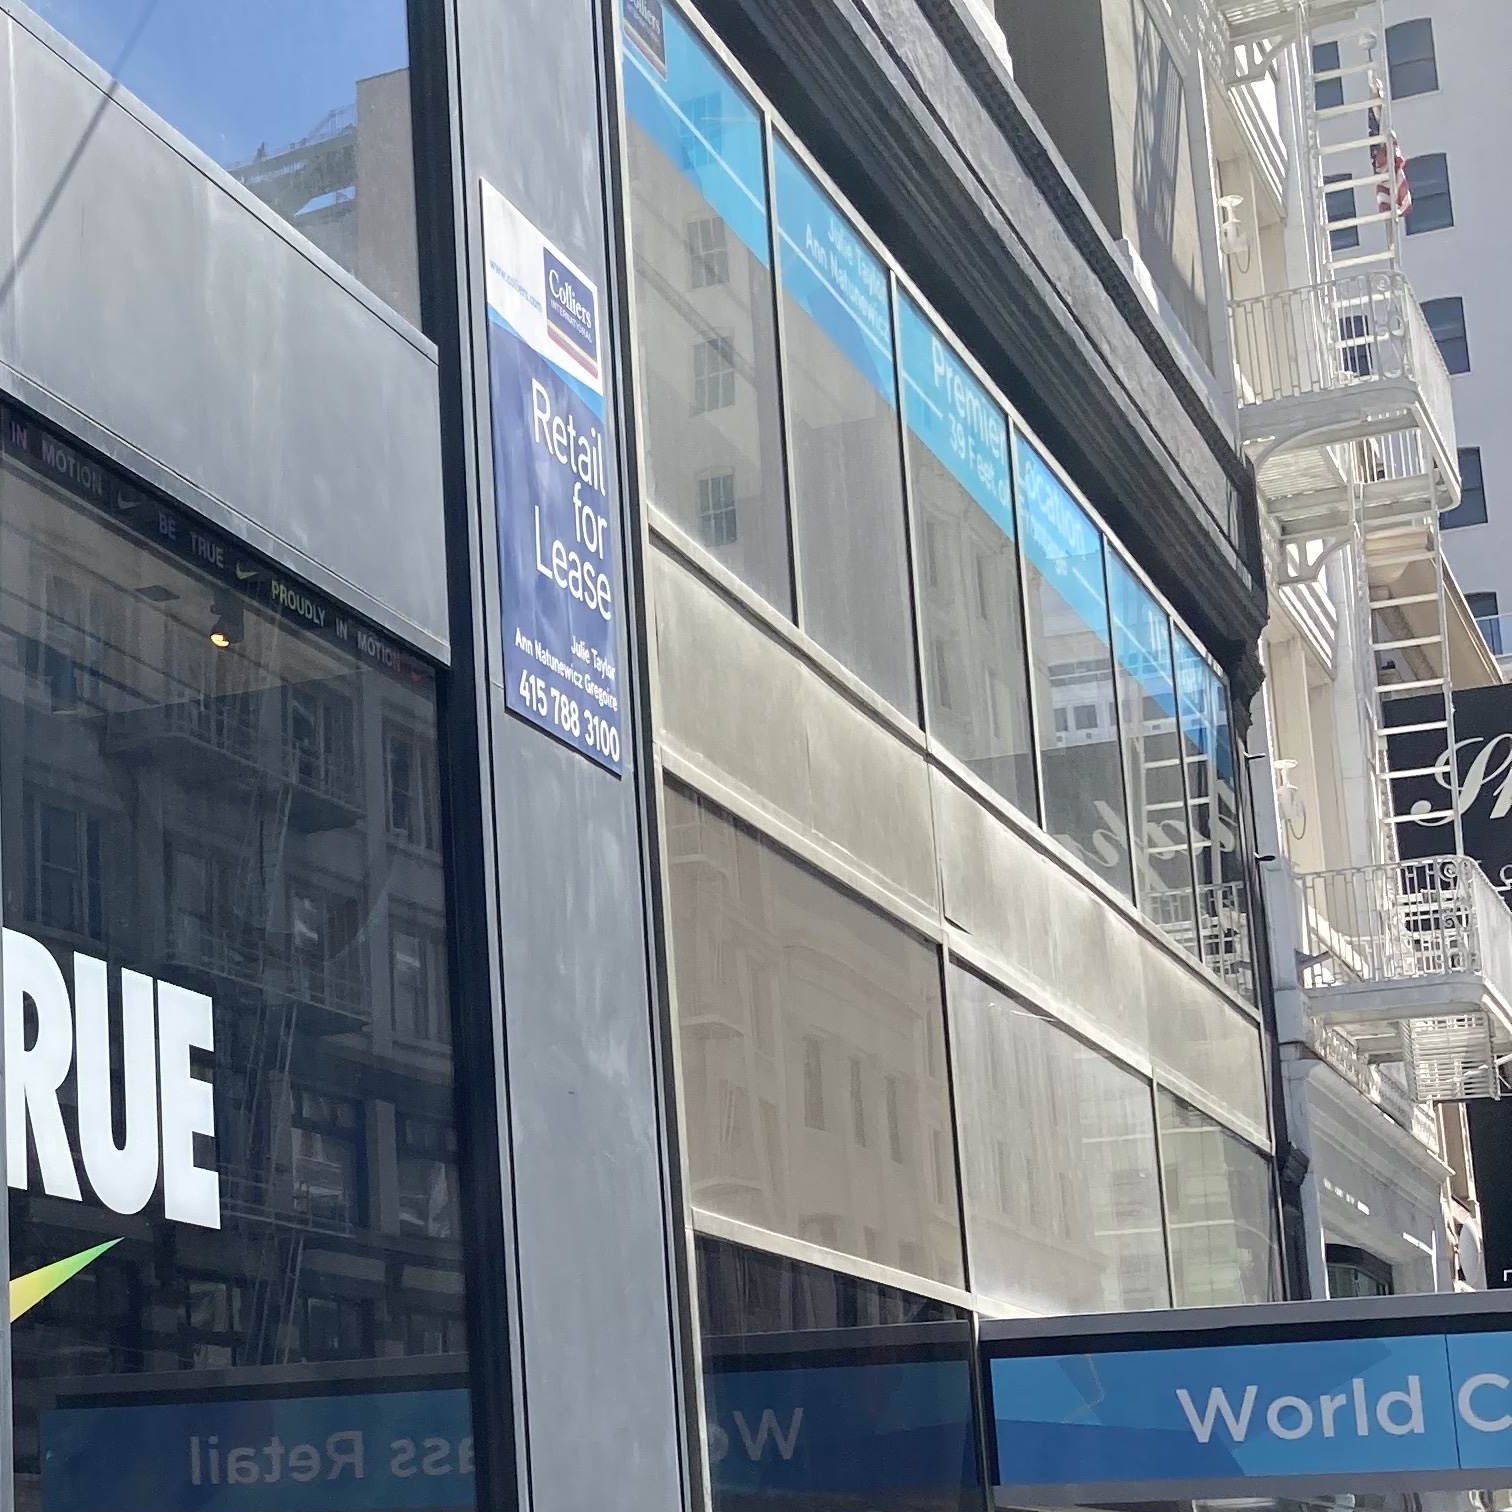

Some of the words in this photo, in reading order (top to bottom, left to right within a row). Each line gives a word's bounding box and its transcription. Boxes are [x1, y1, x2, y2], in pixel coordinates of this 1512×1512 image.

[805, 223, 828, 270] Ann
[549, 269, 592, 329] Colliers
[531, 377, 606, 496] Retail
[931, 336, 1006, 466] Premier
[11, 420, 28, 450] IN
[42, 438, 103, 496] MOTION
[158, 512, 177, 541] BE
[190, 530, 225, 569] TRUE
[573, 481, 607, 560] for
[534, 505, 612, 621] Lease
[271, 579, 326, 628] PROUDLY
[335, 618, 349, 641] IN
[357, 631, 401, 673] MOTION
[571, 635, 590, 664] Julie
[591, 648, 616, 681] Taylor
[515, 627, 534, 656] Ann
[584, 674, 618, 712] Gregoire
[519, 669, 548, 717] 415
[550, 687, 580, 737] 788
[584, 710, 619, 762] 3100
[1176, 1376, 1426, 1444] World
